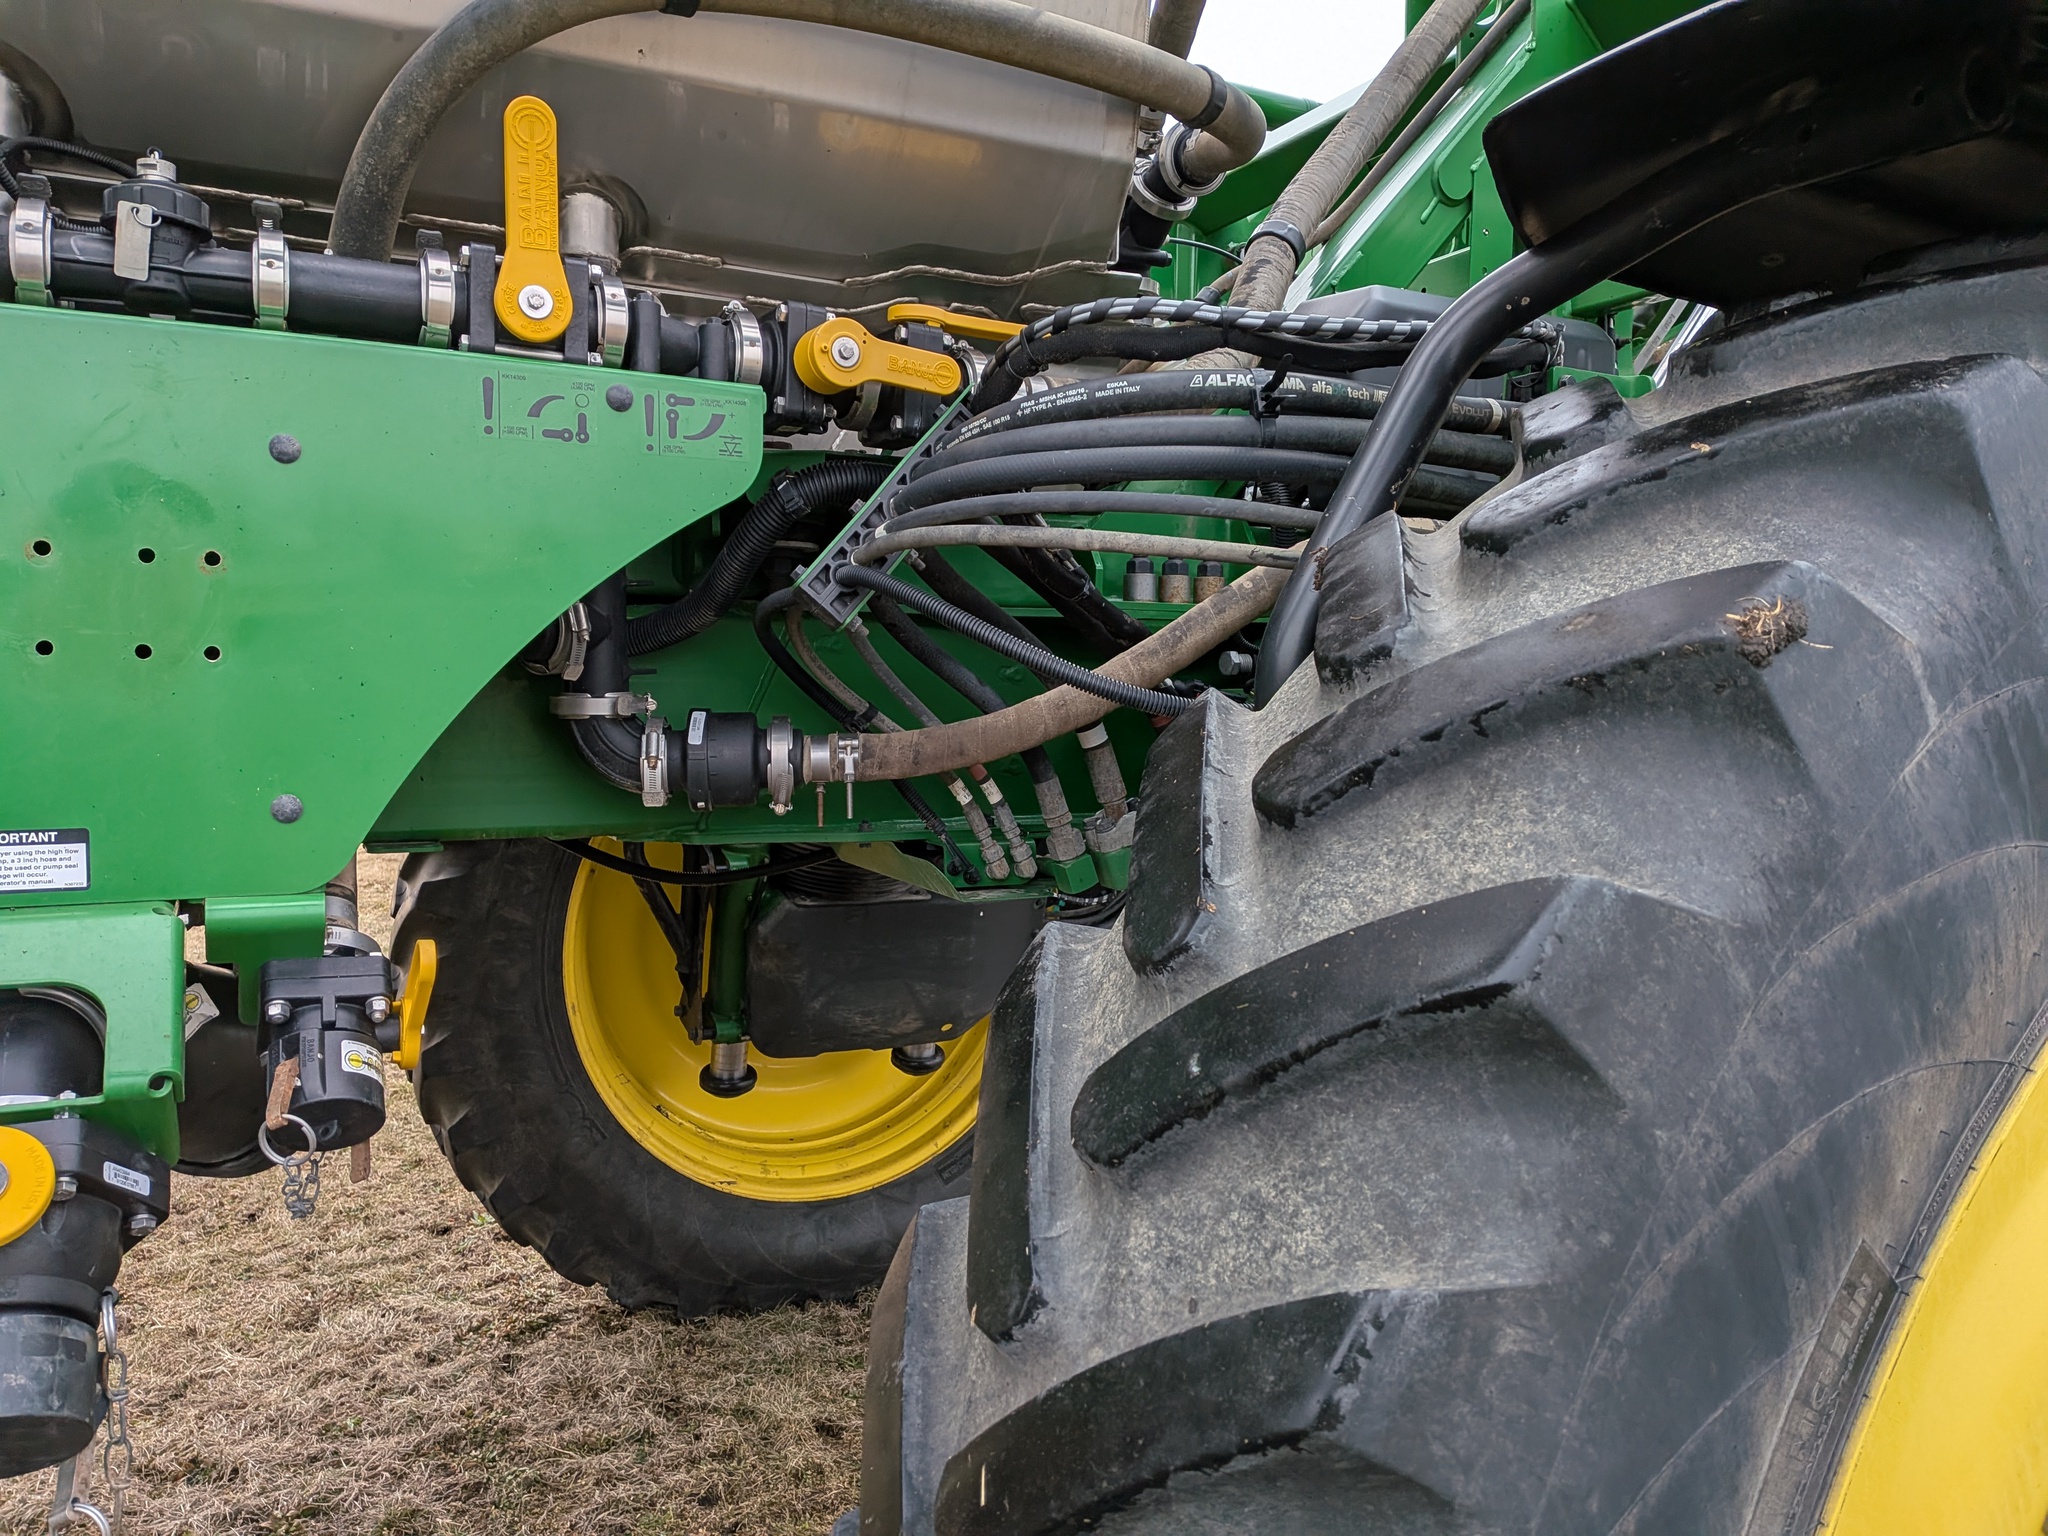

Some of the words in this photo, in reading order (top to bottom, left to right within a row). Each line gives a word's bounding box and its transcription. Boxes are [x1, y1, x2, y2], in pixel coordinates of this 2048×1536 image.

[504, 283, 516, 315] CLOSE
[553, 288, 564, 320] OPEN
[1095, 389, 1114, 397] MADE
[1032, 404, 1046, 412] TYPE
[307, 1038, 315, 1063] BANJO
[1789, 1272, 1874, 1462] MICHELIN
